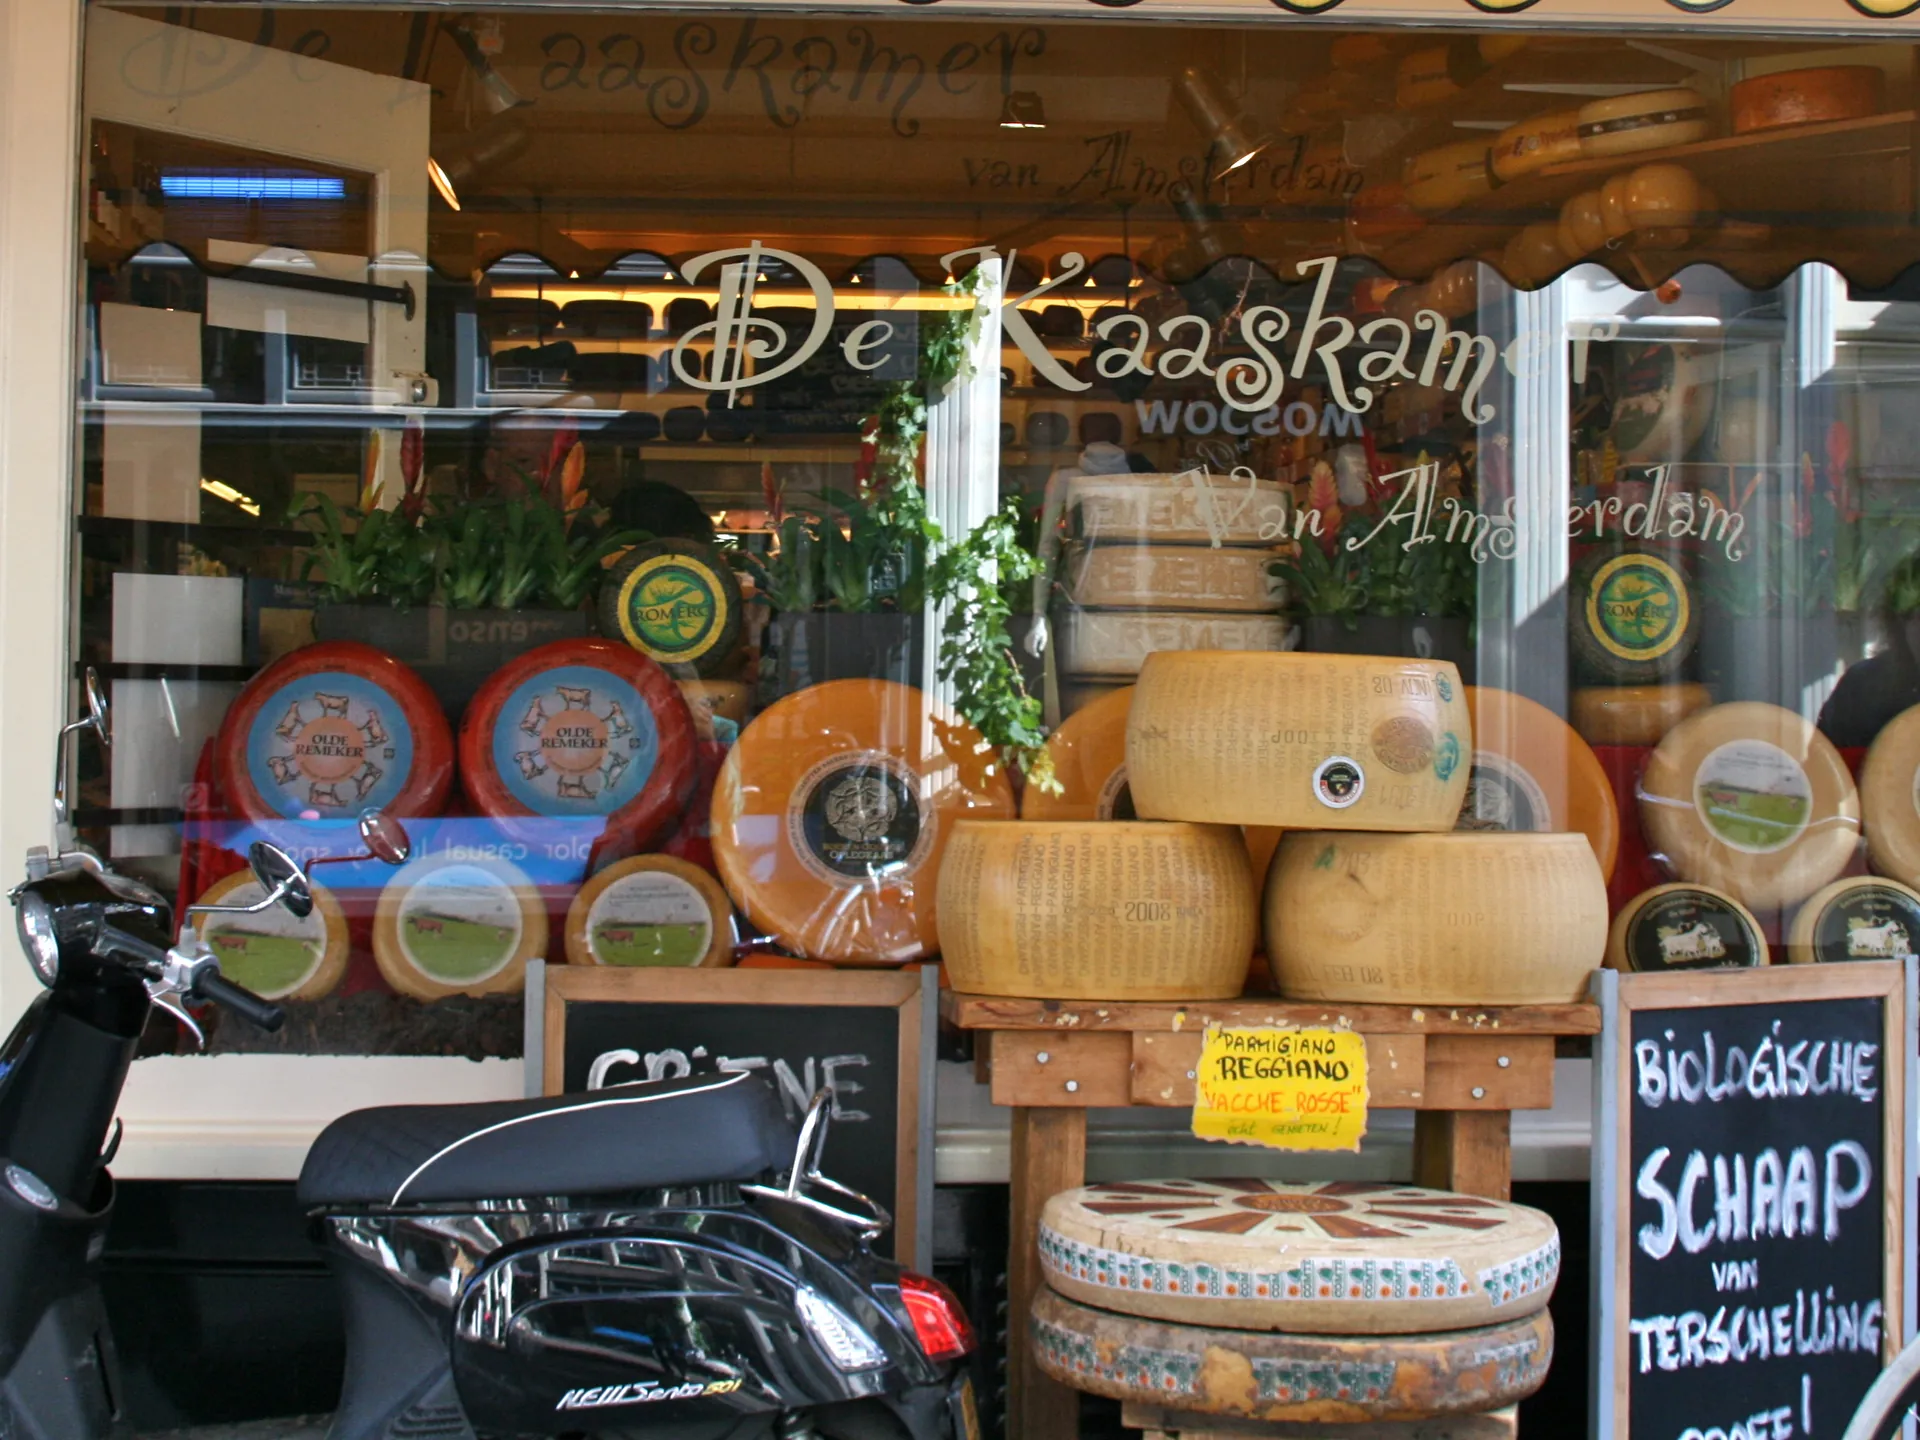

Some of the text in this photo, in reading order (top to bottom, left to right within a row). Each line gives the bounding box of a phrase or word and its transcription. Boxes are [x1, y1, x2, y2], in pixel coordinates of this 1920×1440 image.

[671, 239, 894, 409] De
[1172, 461, 1745, 562] Van Amserdam
[311, 734, 348, 745] OLDE
[556, 726, 594, 737] OLDE
[295, 744, 364, 757] REMEKER
[541, 738, 608, 749] REMEKER
[1125, 901, 1171, 923] 2008
[1223, 1032, 1336, 1055] PARMIGIANO
[1216, 1055, 1349, 1082] REGGIANO
[1637, 1139, 1872, 1260] SCHAAP
[1711, 1258, 1758, 1292] VAN
